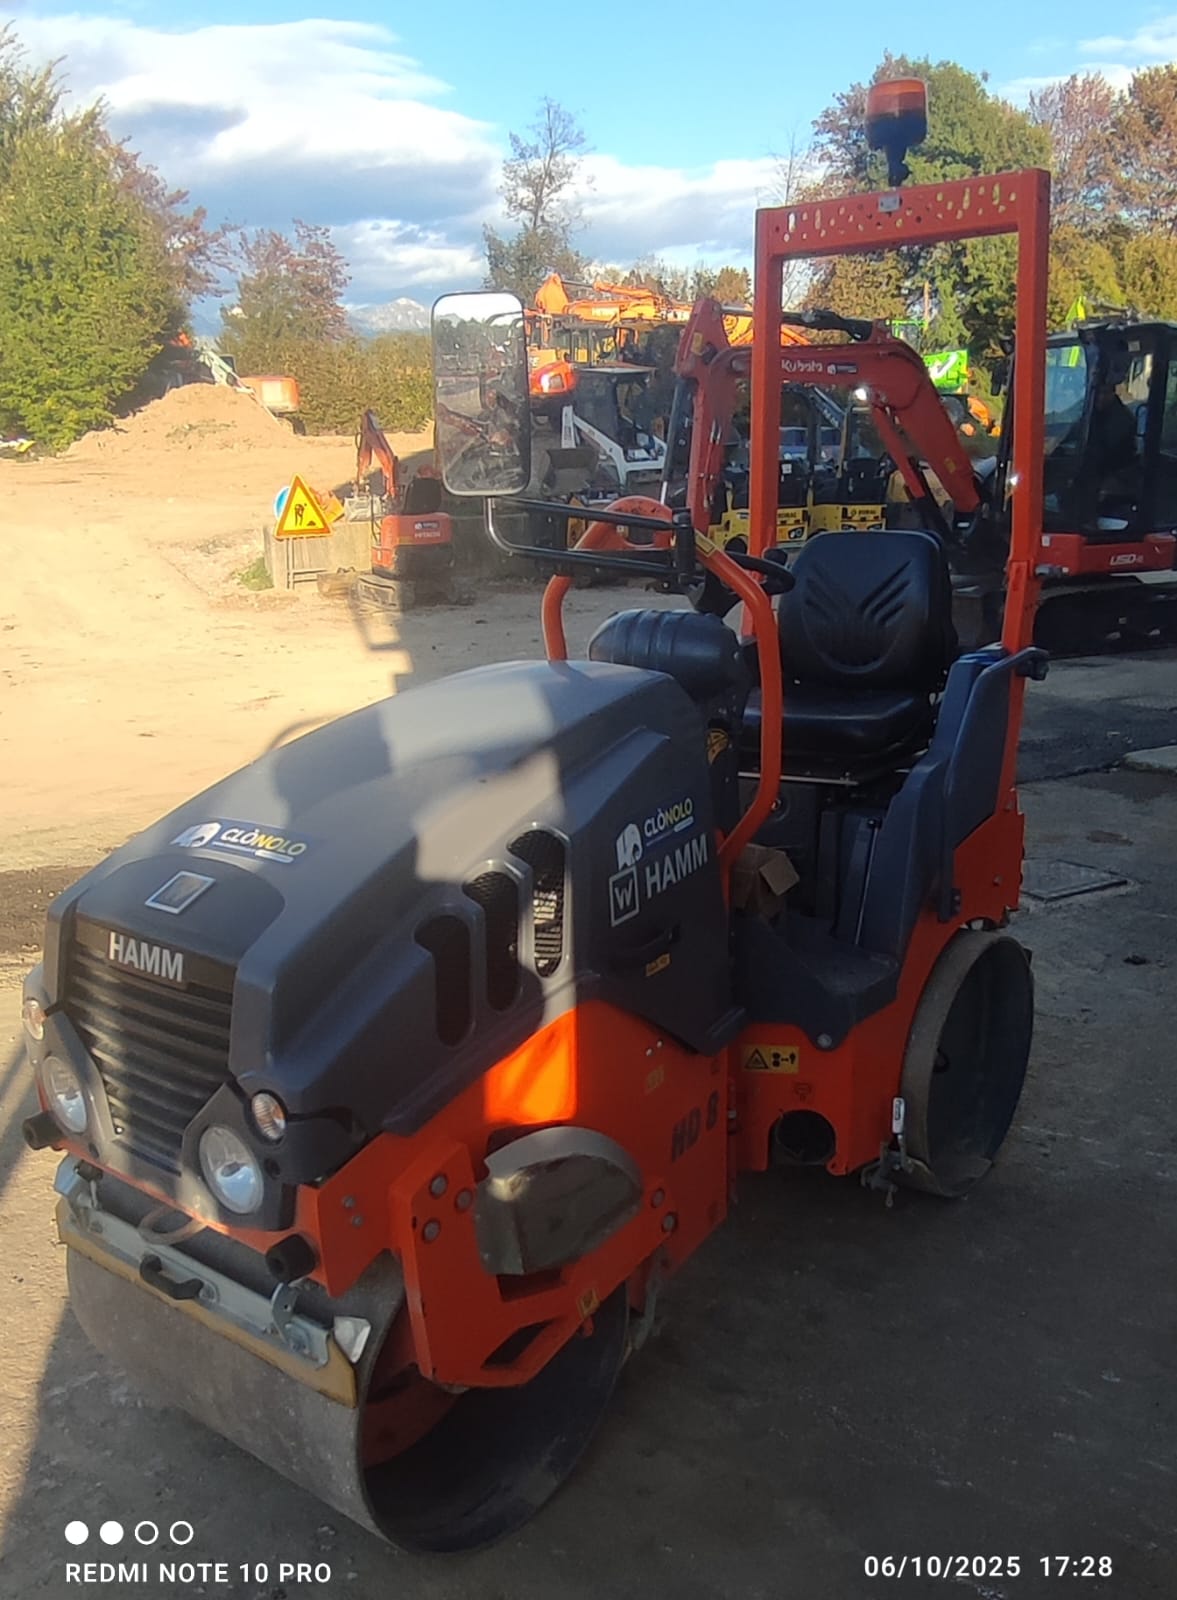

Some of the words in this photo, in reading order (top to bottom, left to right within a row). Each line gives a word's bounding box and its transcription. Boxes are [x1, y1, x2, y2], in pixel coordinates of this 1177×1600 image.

[781, 360, 823, 372] Kubota
[643, 797, 693, 837] CLÒNOLO
[220, 828, 307, 856] CLÒNOLO
[645, 832, 708, 899] HAMM
[109, 931, 184, 983] HAMM
[671, 1105, 702, 1164] HD
